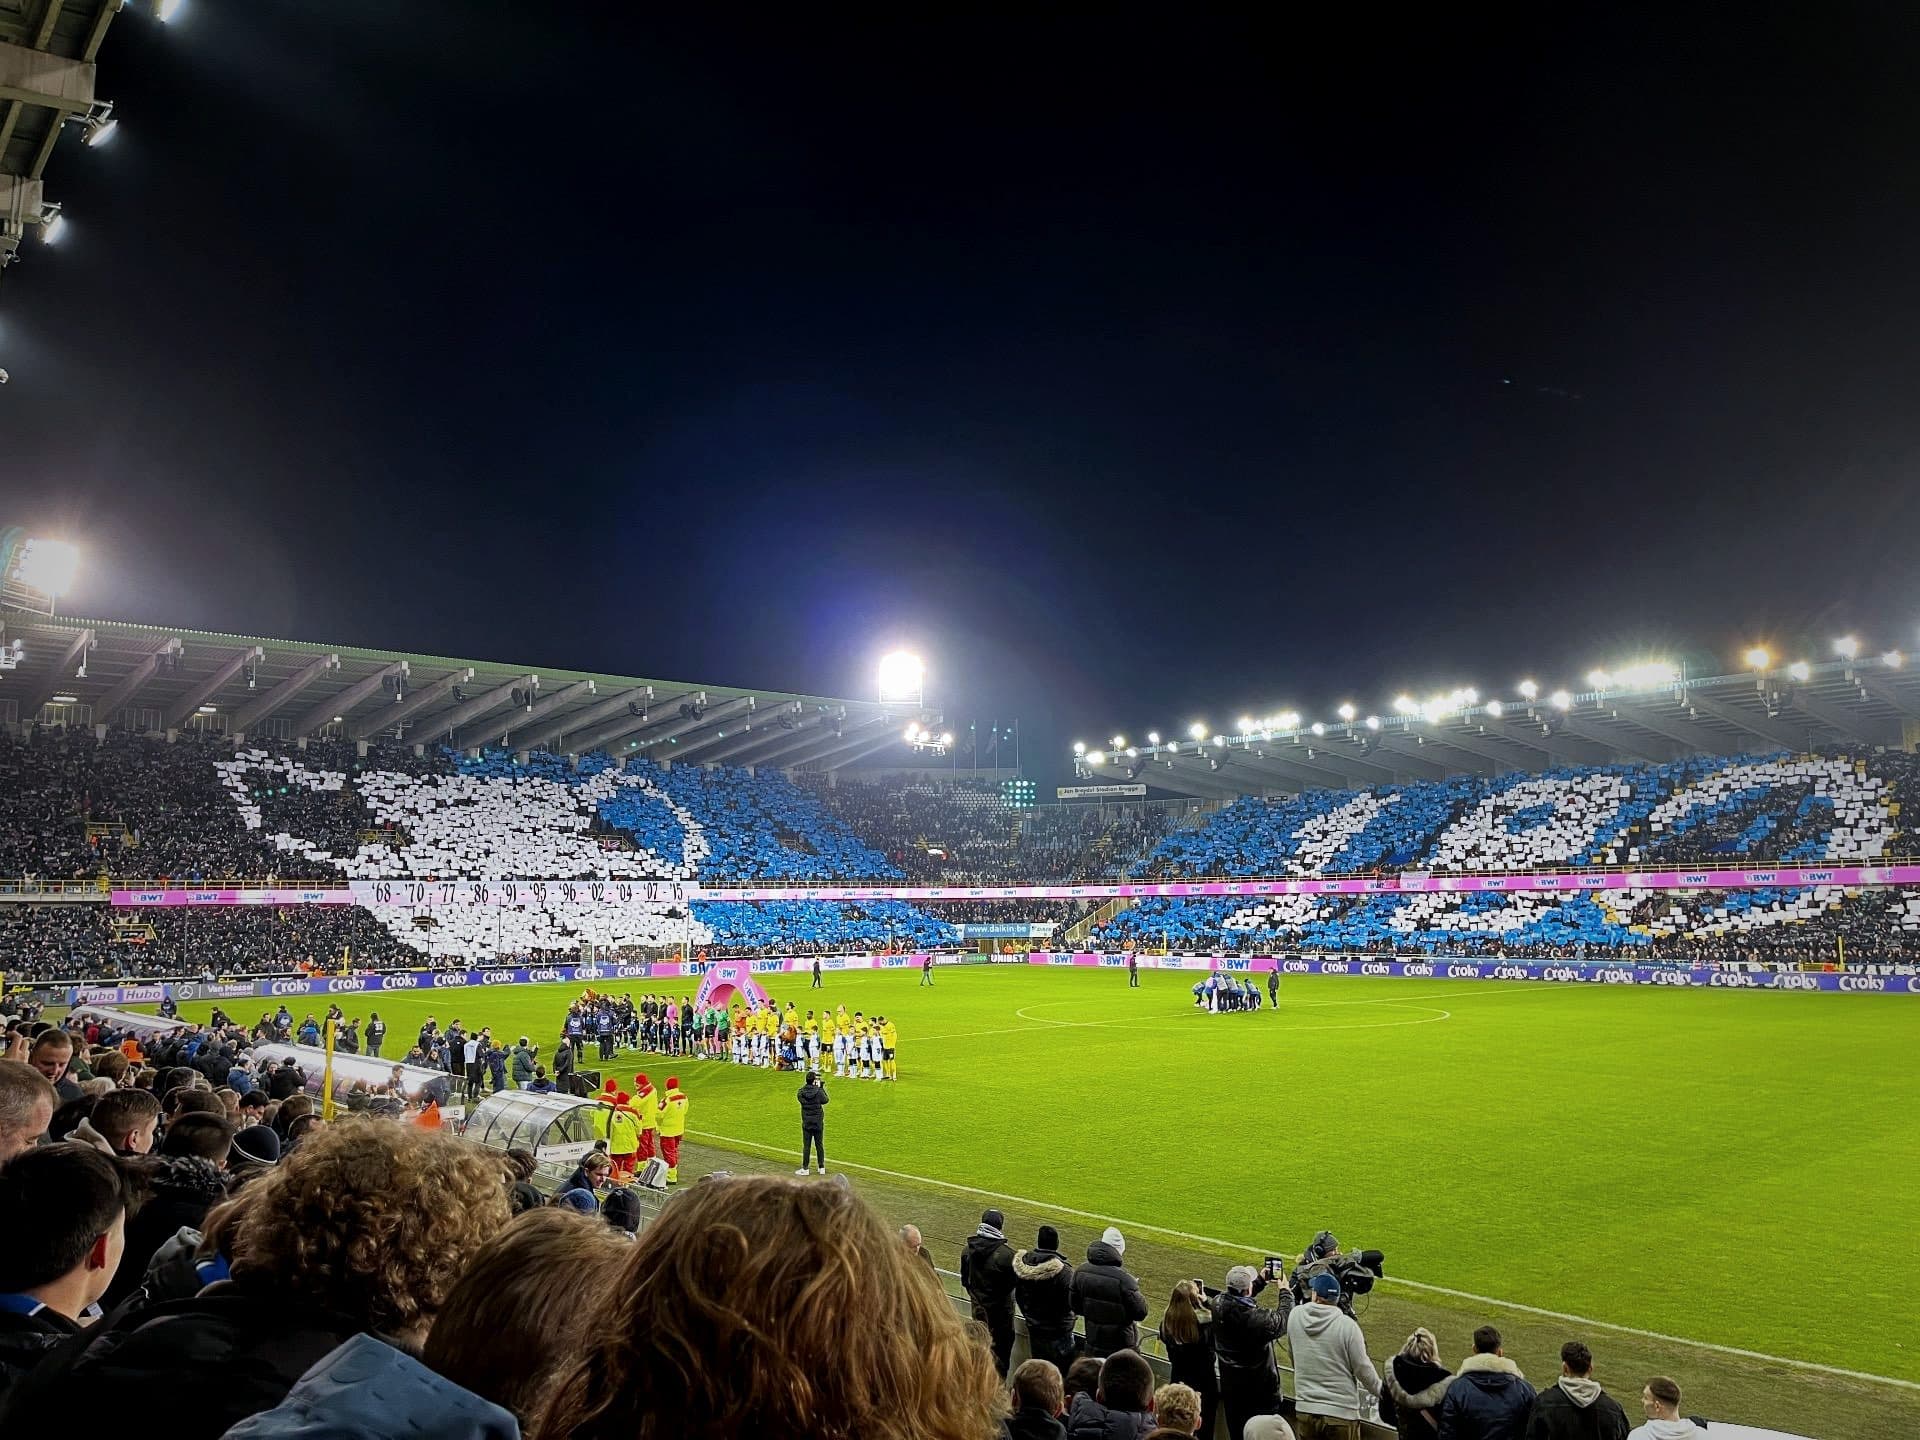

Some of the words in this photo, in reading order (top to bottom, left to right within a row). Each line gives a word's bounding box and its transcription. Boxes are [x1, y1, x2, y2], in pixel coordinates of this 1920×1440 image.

[1585, 877, 1605, 885] BWT
[1687, 875, 1708, 883] BWT
[1753, 874, 1776, 882] BWT
[1809, 872, 1833, 881] BWT
[140, 893, 164, 902] BWT
[195, 893, 218, 901] BWT
[303, 892, 324, 900] BWT
[371, 882, 391, 903] '68
[405, 883, 425, 902] '70
[438, 883, 456, 903] '77
[470, 883, 489, 903] '86
[502, 883, 517, 902] '91
[529, 882, 547, 902] '95
[558, 882, 576, 901] '96
[588, 882, 605, 901] '02
[616, 882, 633, 901] '04
[643, 882, 658, 901] '07
[669, 882, 683, 900] '15
[967, 923, 1027, 933] www.daikin.be
[888, 955, 909, 965] BWT
[936, 953, 962, 964] UNIBET
[991, 953, 1024, 963] UNIBET
[1055, 954, 1073, 964] BWT
[1106, 955, 1126, 965] BWT
[1227, 959, 1250, 970] BWT
[617, 963, 646, 977] Croky
[759, 960, 784, 971] BWT
[1283, 960, 1310, 973] Croky
[1321, 961, 1349, 974] Croky
[1361, 962, 1390, 975] Croky
[1403, 963, 1433, 977] Croky
[1448, 964, 1479, 978] Croky
[1494, 965, 1528, 979] Croky
[434, 971, 468, 986] Croky
[482, 970, 515, 985] Croky
[529, 966, 560, 981] Croky
[722, 968, 737, 979] BWT
[1543, 966, 1579, 980] Croky
[1596, 967, 1633, 982] Croky
[1652, 969, 1691, 985] Croky
[1710, 971, 1753, 986] Croky
[271, 978, 311, 995] Croky
[328, 976, 366, 992] Croky
[382, 975, 418, 991] Croky
[1774, 973, 1817, 988] Croky
[1838, 973, 1885, 991] Croky
[126, 988, 161, 1000] Hubo
